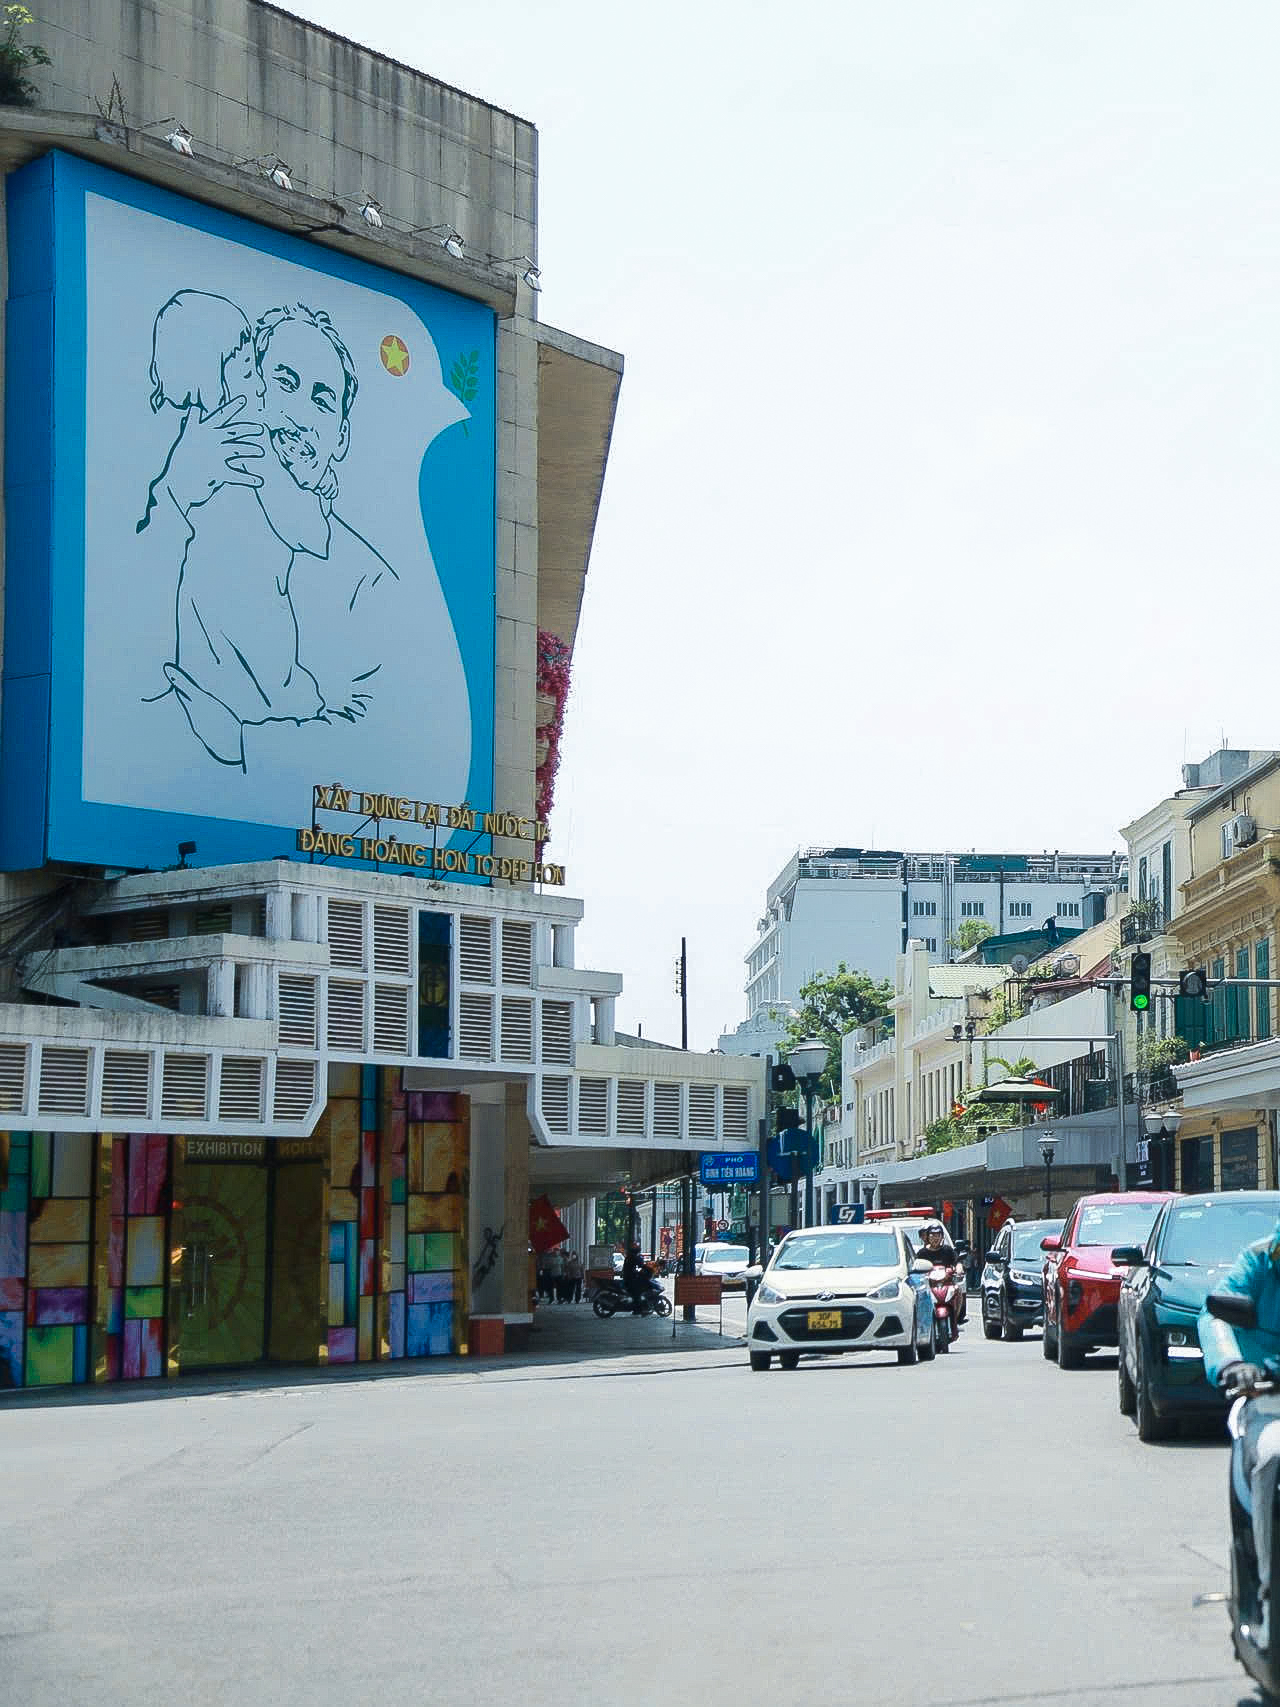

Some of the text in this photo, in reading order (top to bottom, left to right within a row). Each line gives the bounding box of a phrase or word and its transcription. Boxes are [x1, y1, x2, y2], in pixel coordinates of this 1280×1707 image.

[316, 783, 352, 811] XÂY
[415, 800, 440, 829] LẠI
[447, 801, 478, 830] ĐẤT
[362, 834, 426, 866] HOÀNG
[186, 1141, 263, 1156] EXHIBITION
